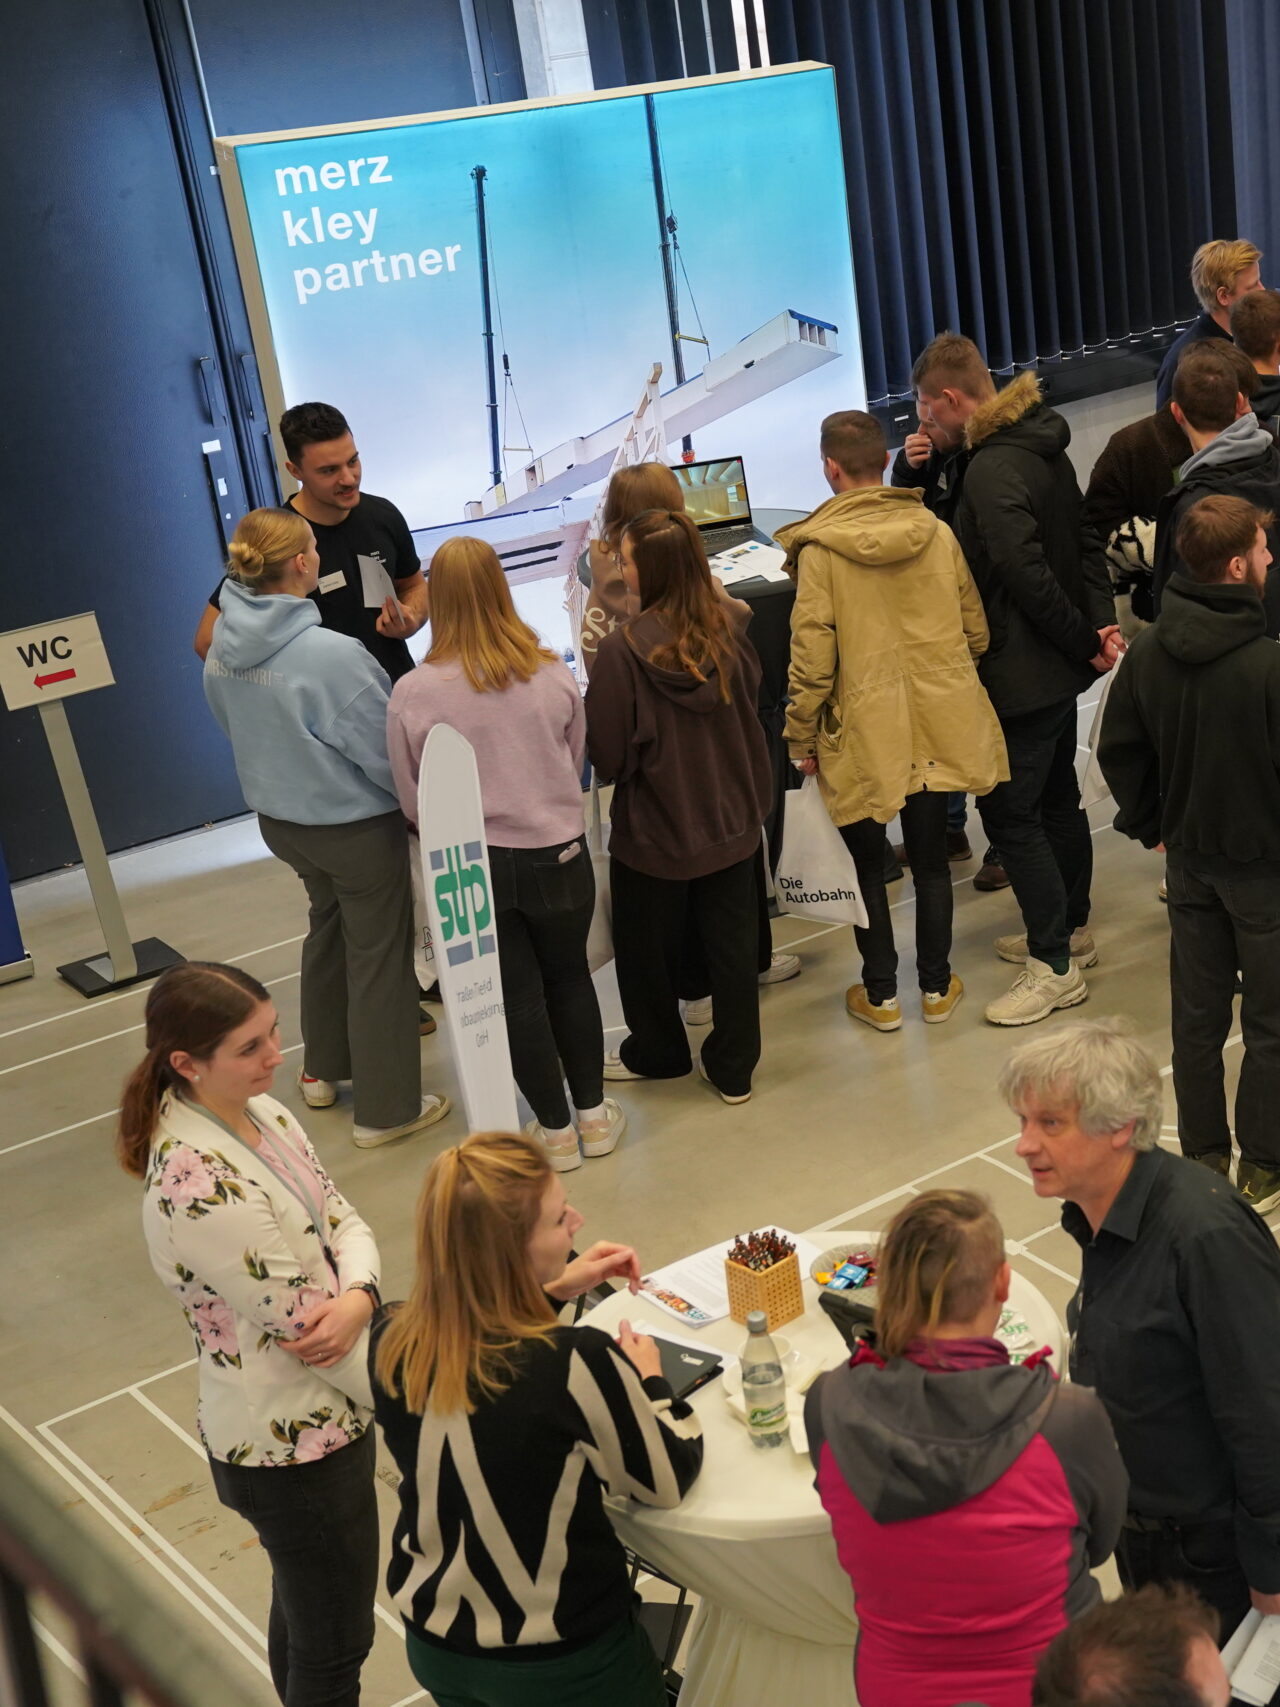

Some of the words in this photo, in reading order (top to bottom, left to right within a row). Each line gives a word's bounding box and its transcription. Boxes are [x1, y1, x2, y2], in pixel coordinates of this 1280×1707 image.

[275, 156, 393, 196] merz
[282, 206, 378, 247] kley
[293, 244, 462, 305] partner
[16, 635, 73, 668] WC
[779, 876, 803, 889] Die
[786, 887, 856, 904] Autobahn
